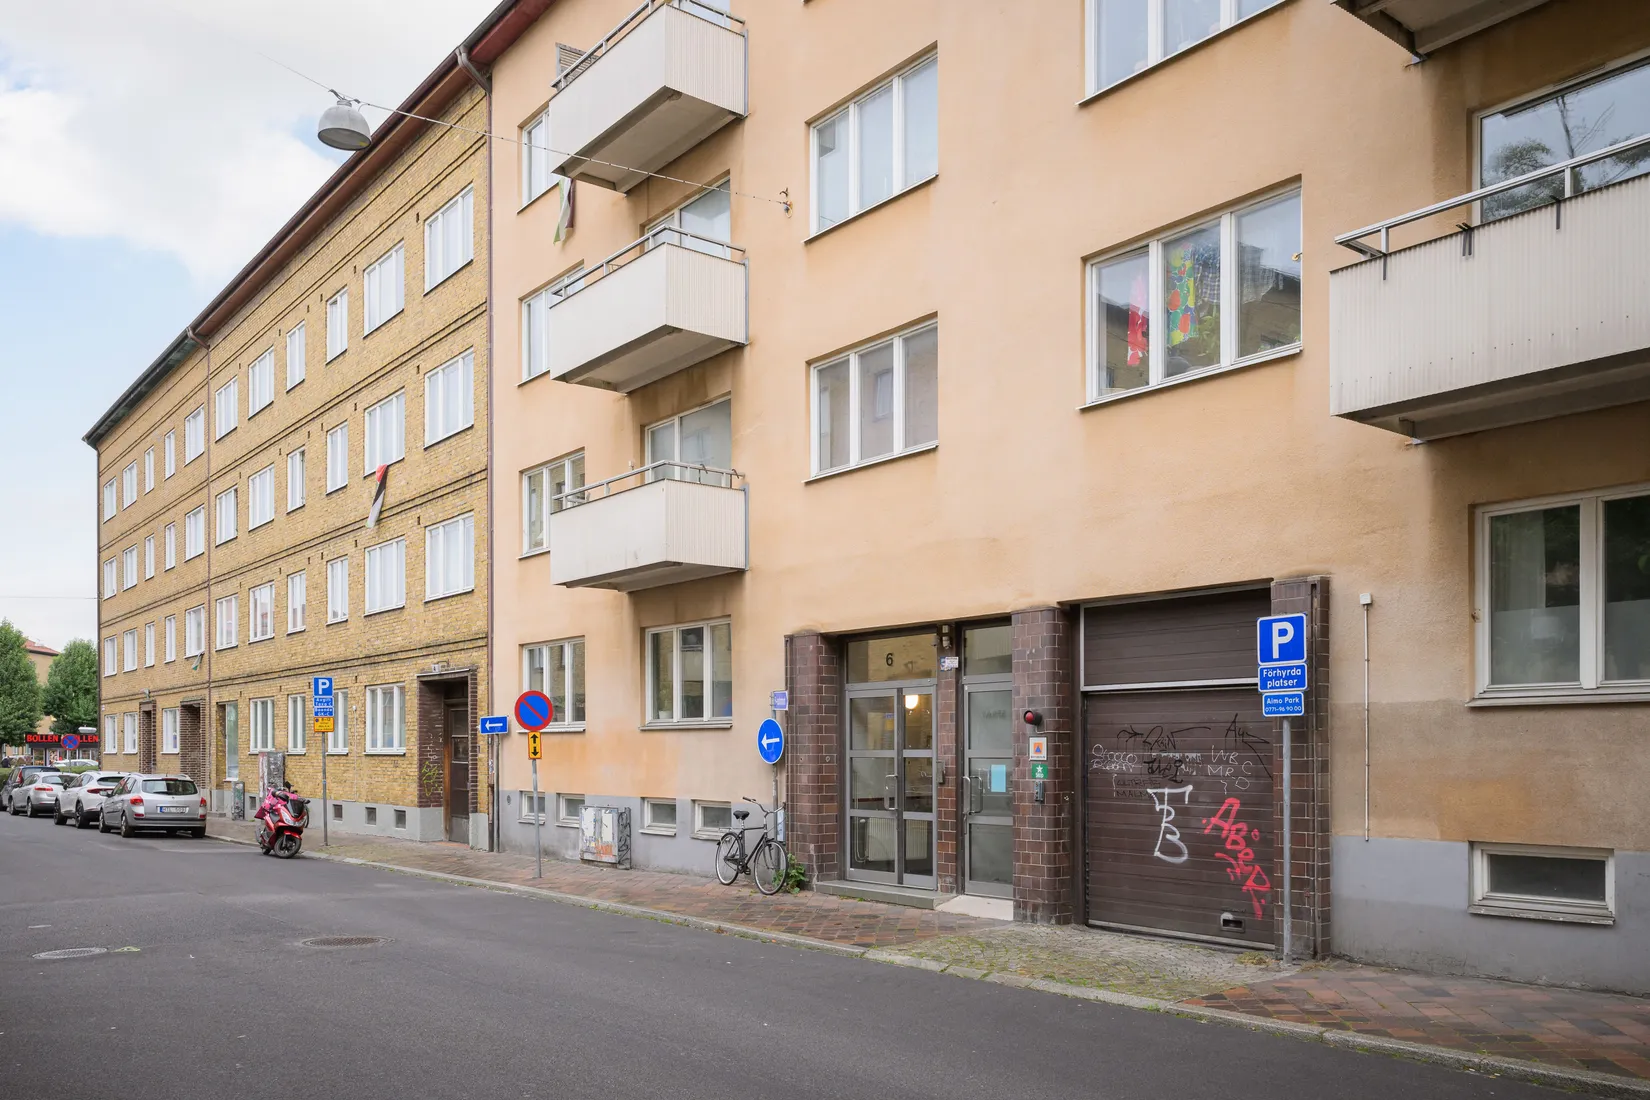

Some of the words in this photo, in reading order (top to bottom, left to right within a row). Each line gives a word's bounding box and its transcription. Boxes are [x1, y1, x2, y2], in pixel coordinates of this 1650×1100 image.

[1272, 622, 1294, 659] P
[886, 653, 893, 666] 6
[1263, 668, 1301, 678] Förhyrda
[318, 679, 330, 694] P
[1267, 679, 1297, 688] platser
